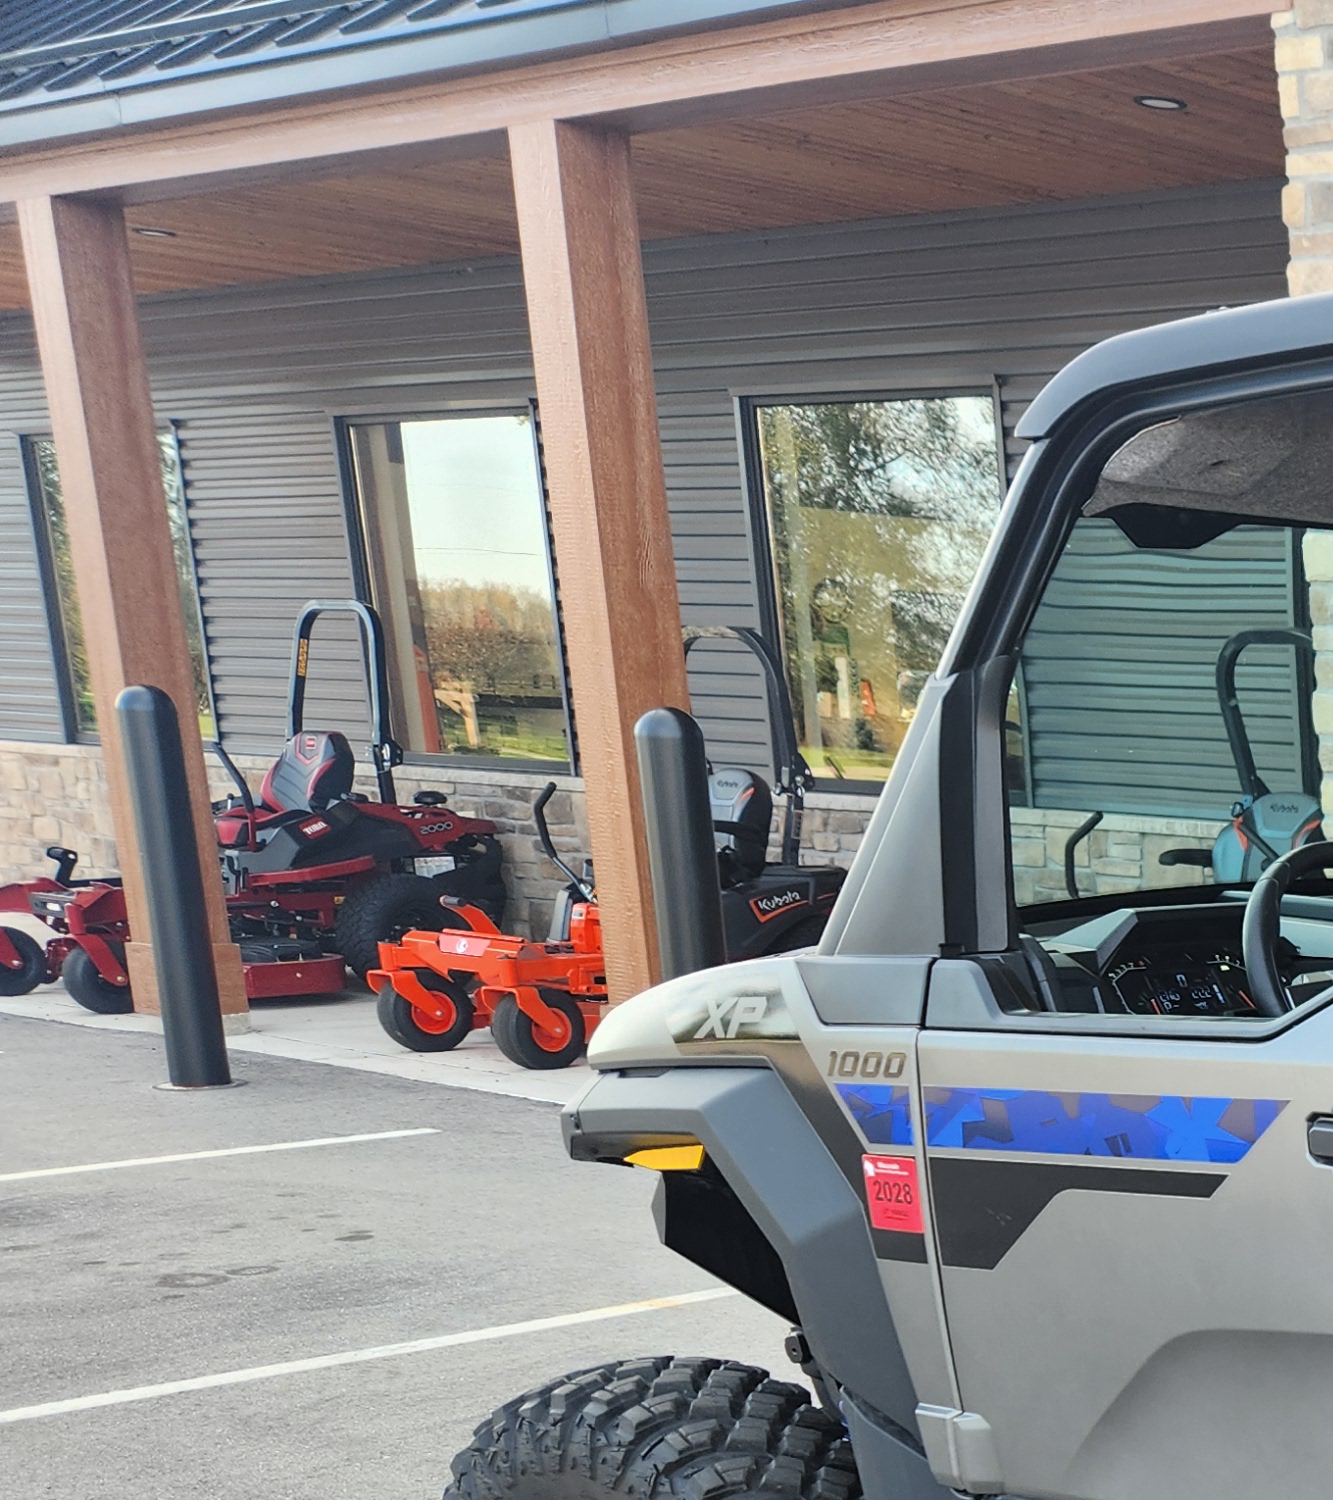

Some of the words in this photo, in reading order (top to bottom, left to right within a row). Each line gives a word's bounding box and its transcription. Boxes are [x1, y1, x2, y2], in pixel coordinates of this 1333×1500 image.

[302, 821, 328, 836] TORO
[420, 822, 453, 835] 2000
[757, 891, 801, 912] Kubota
[693, 997, 767, 1039] XP
[827, 1051, 907, 1078] 1000
[873, 1180, 913, 1205] 2028
